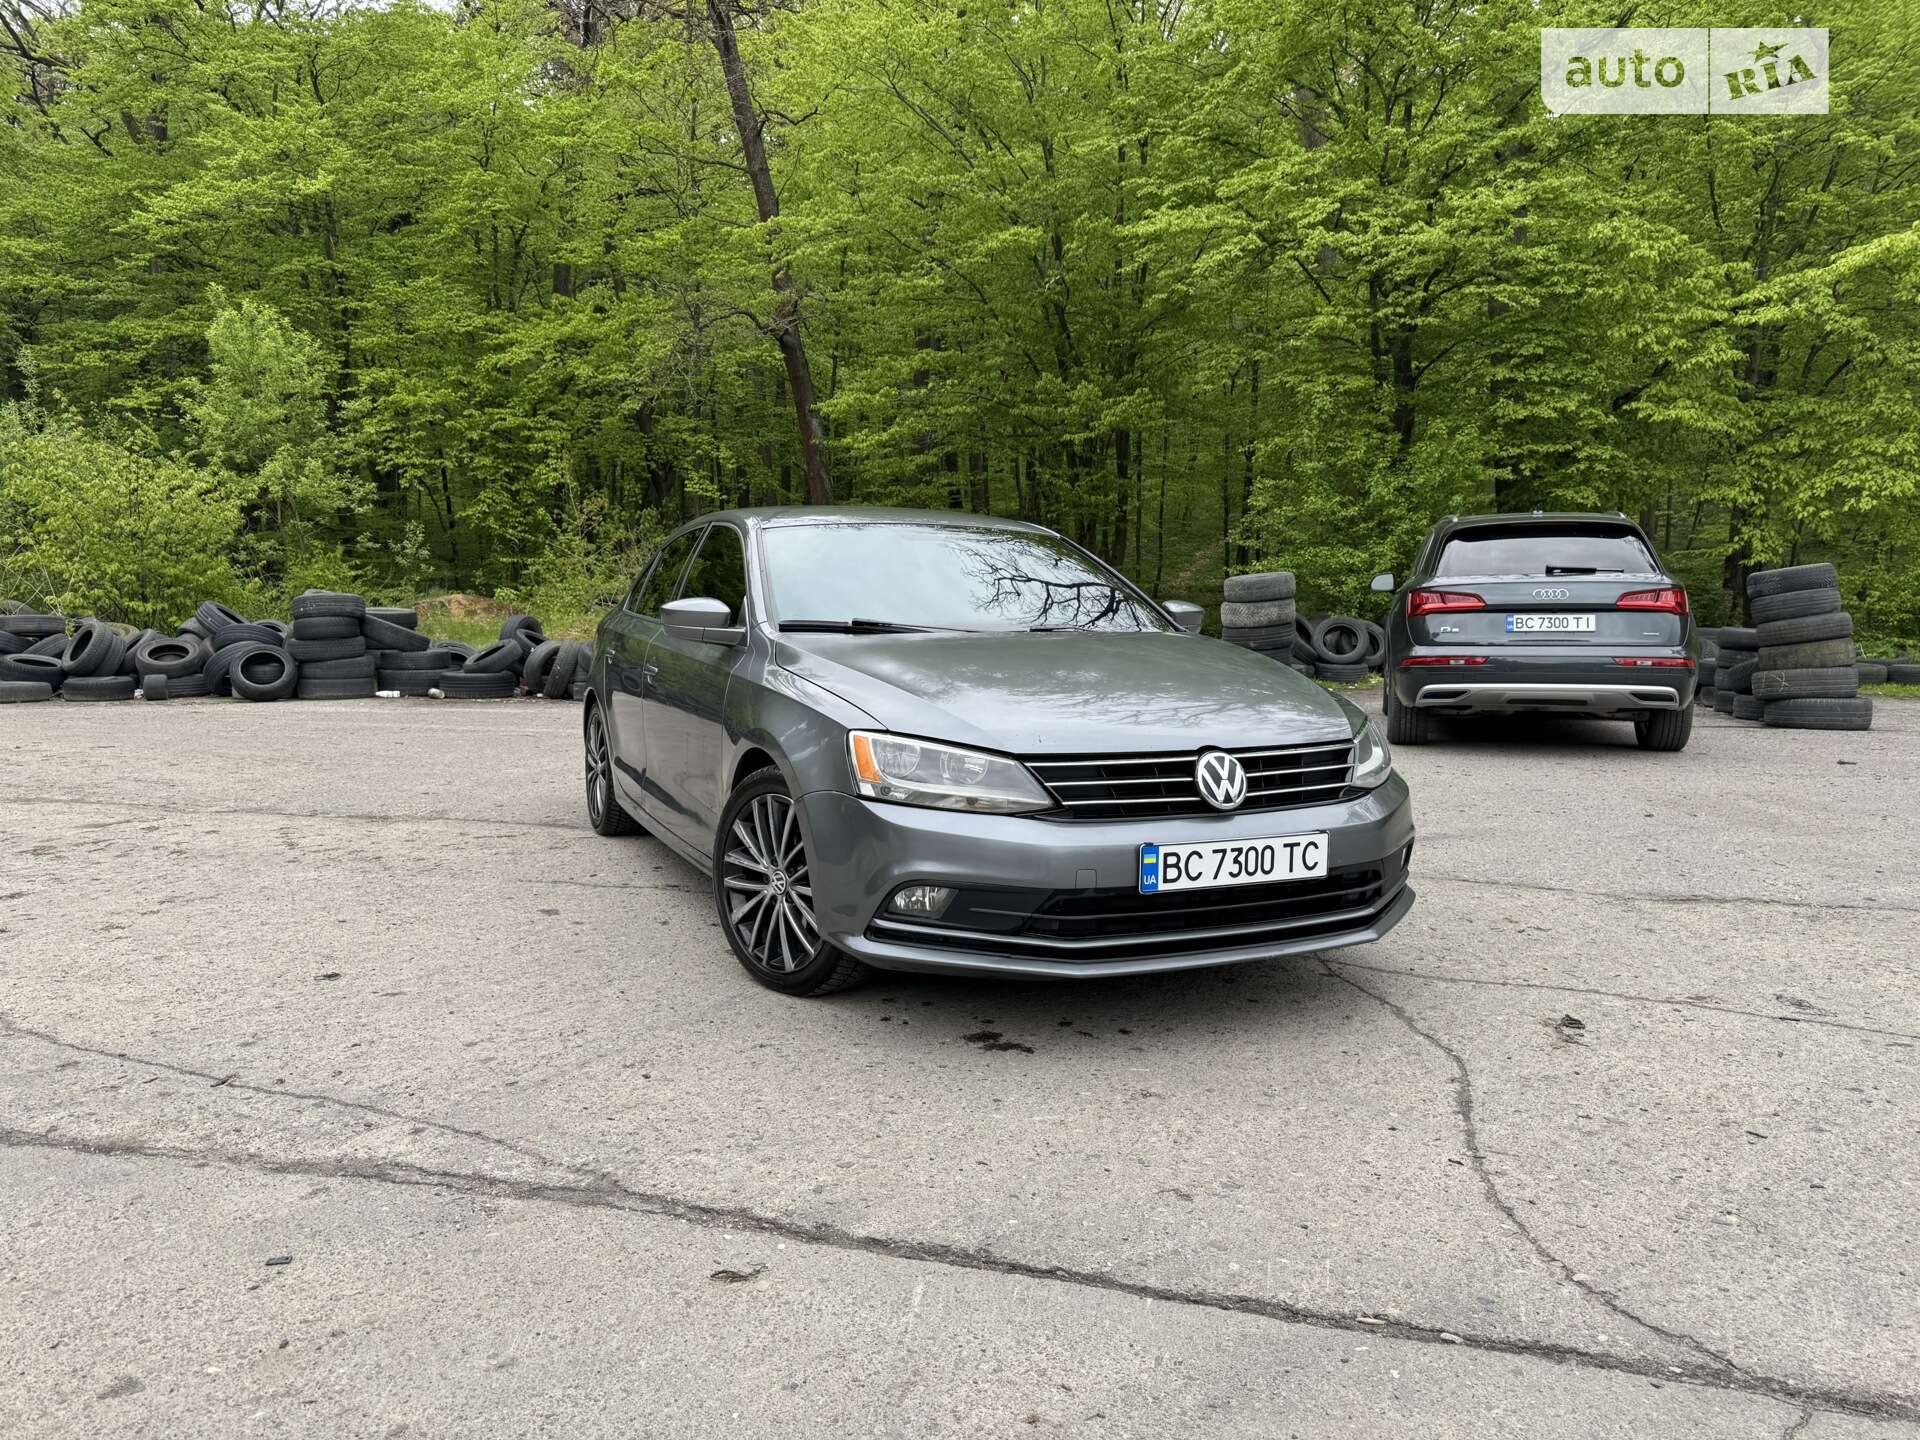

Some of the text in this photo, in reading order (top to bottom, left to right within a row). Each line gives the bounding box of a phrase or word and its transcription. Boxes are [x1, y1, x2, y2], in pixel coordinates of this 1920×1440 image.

[1515, 617, 1534, 629] BC
[1538, 617, 1569, 629] 7300
[1572, 617, 1590, 629] TI
[1196, 751, 1246, 809] VW
[1162, 840, 1320, 884] BC 7300 TC
[1144, 874, 1157, 885] UA
